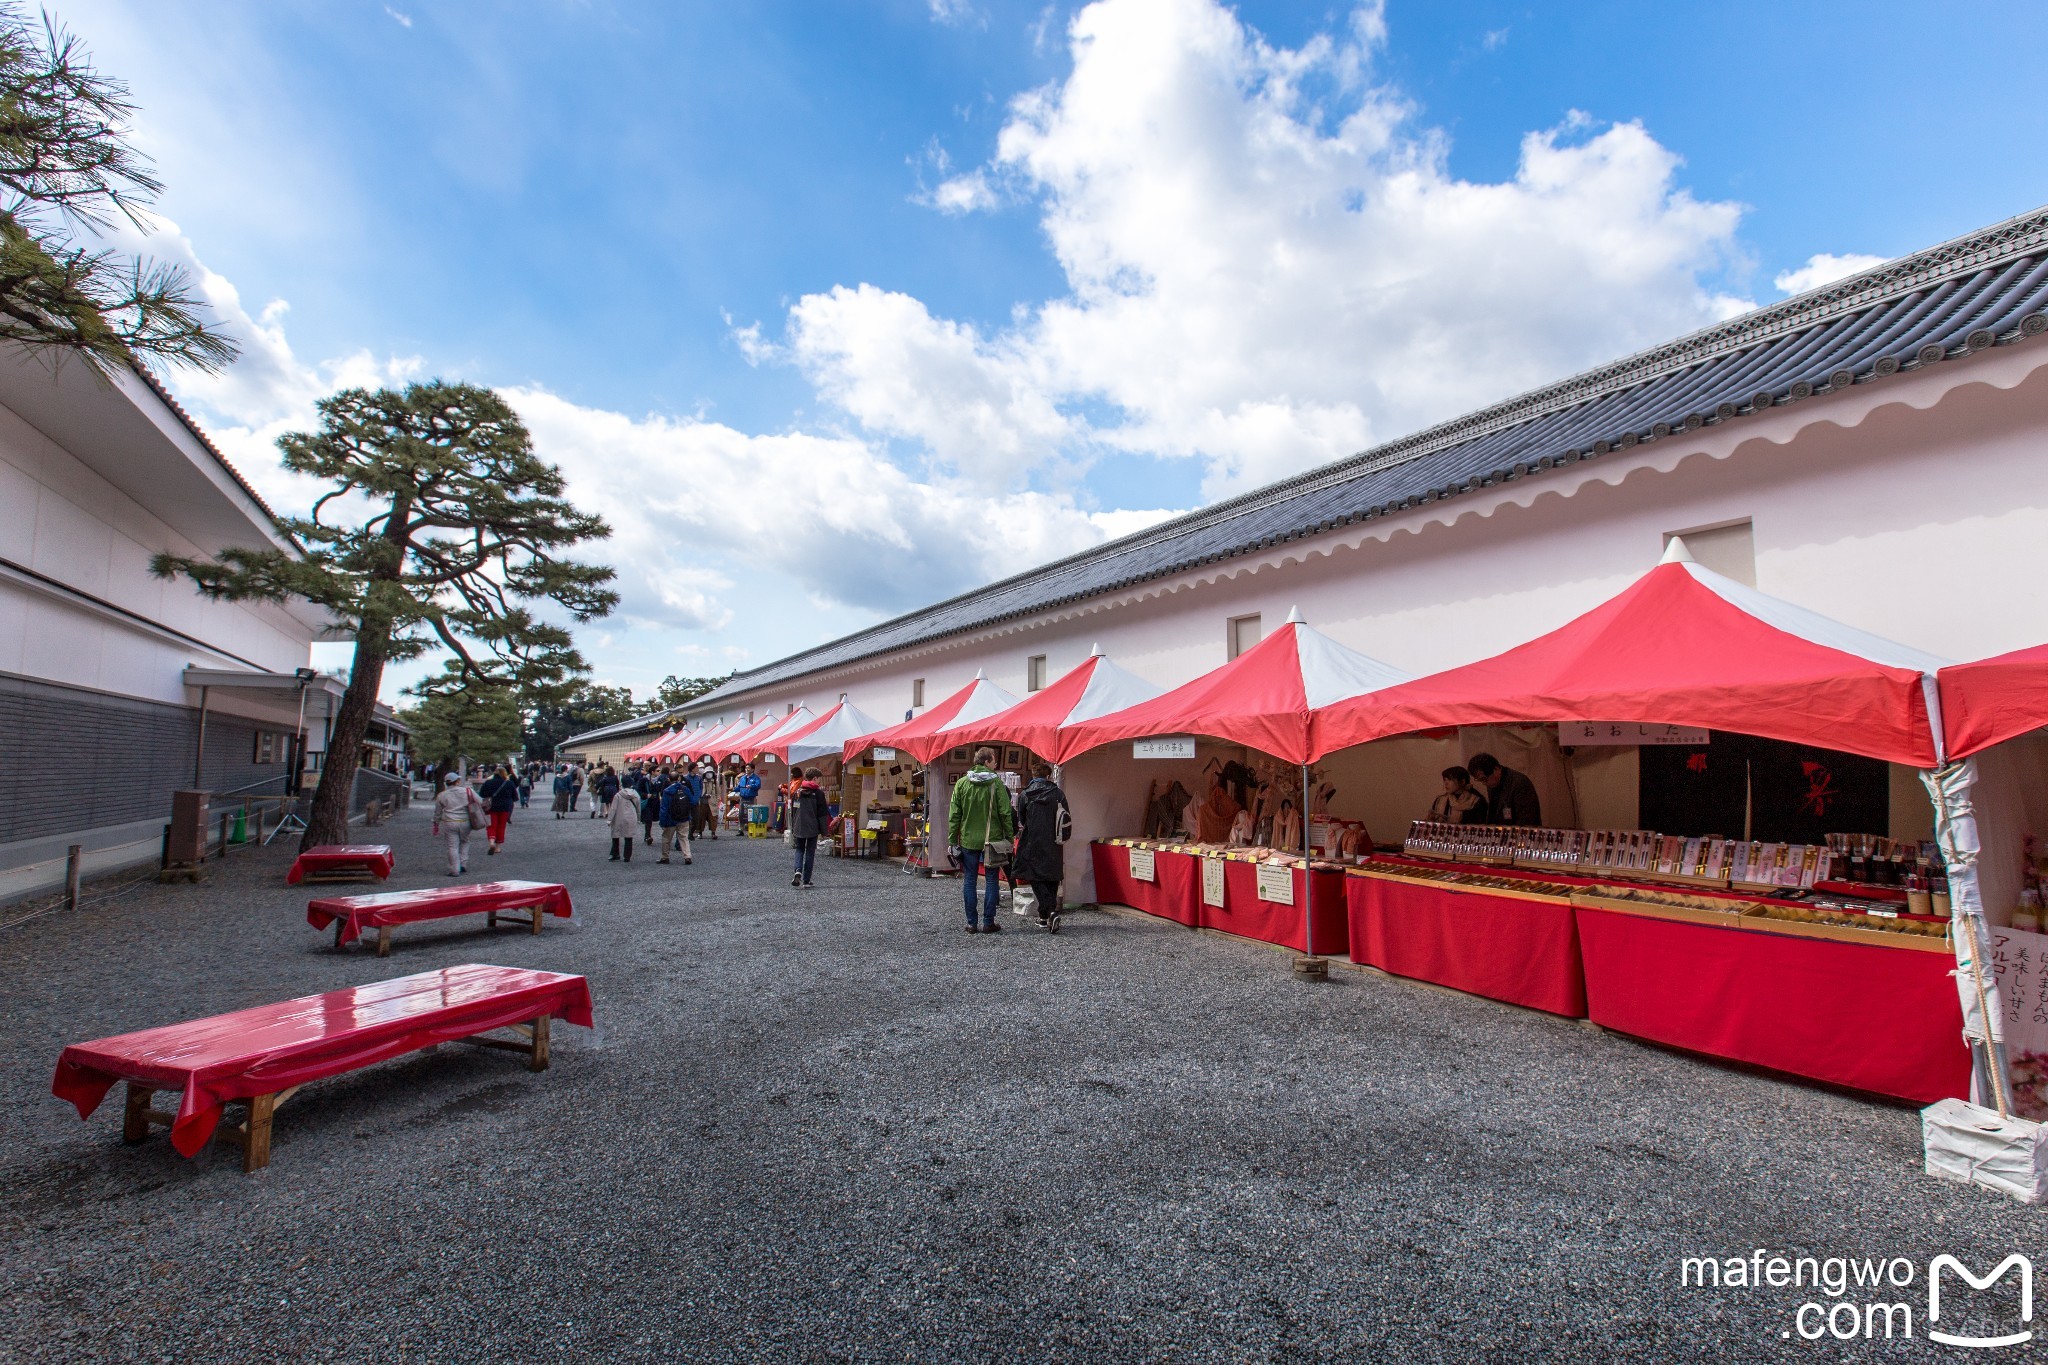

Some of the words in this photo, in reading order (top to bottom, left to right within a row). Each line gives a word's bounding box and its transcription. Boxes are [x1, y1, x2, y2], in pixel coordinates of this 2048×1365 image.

[2008, 947, 2030, 1023] 美味しい甘さ
